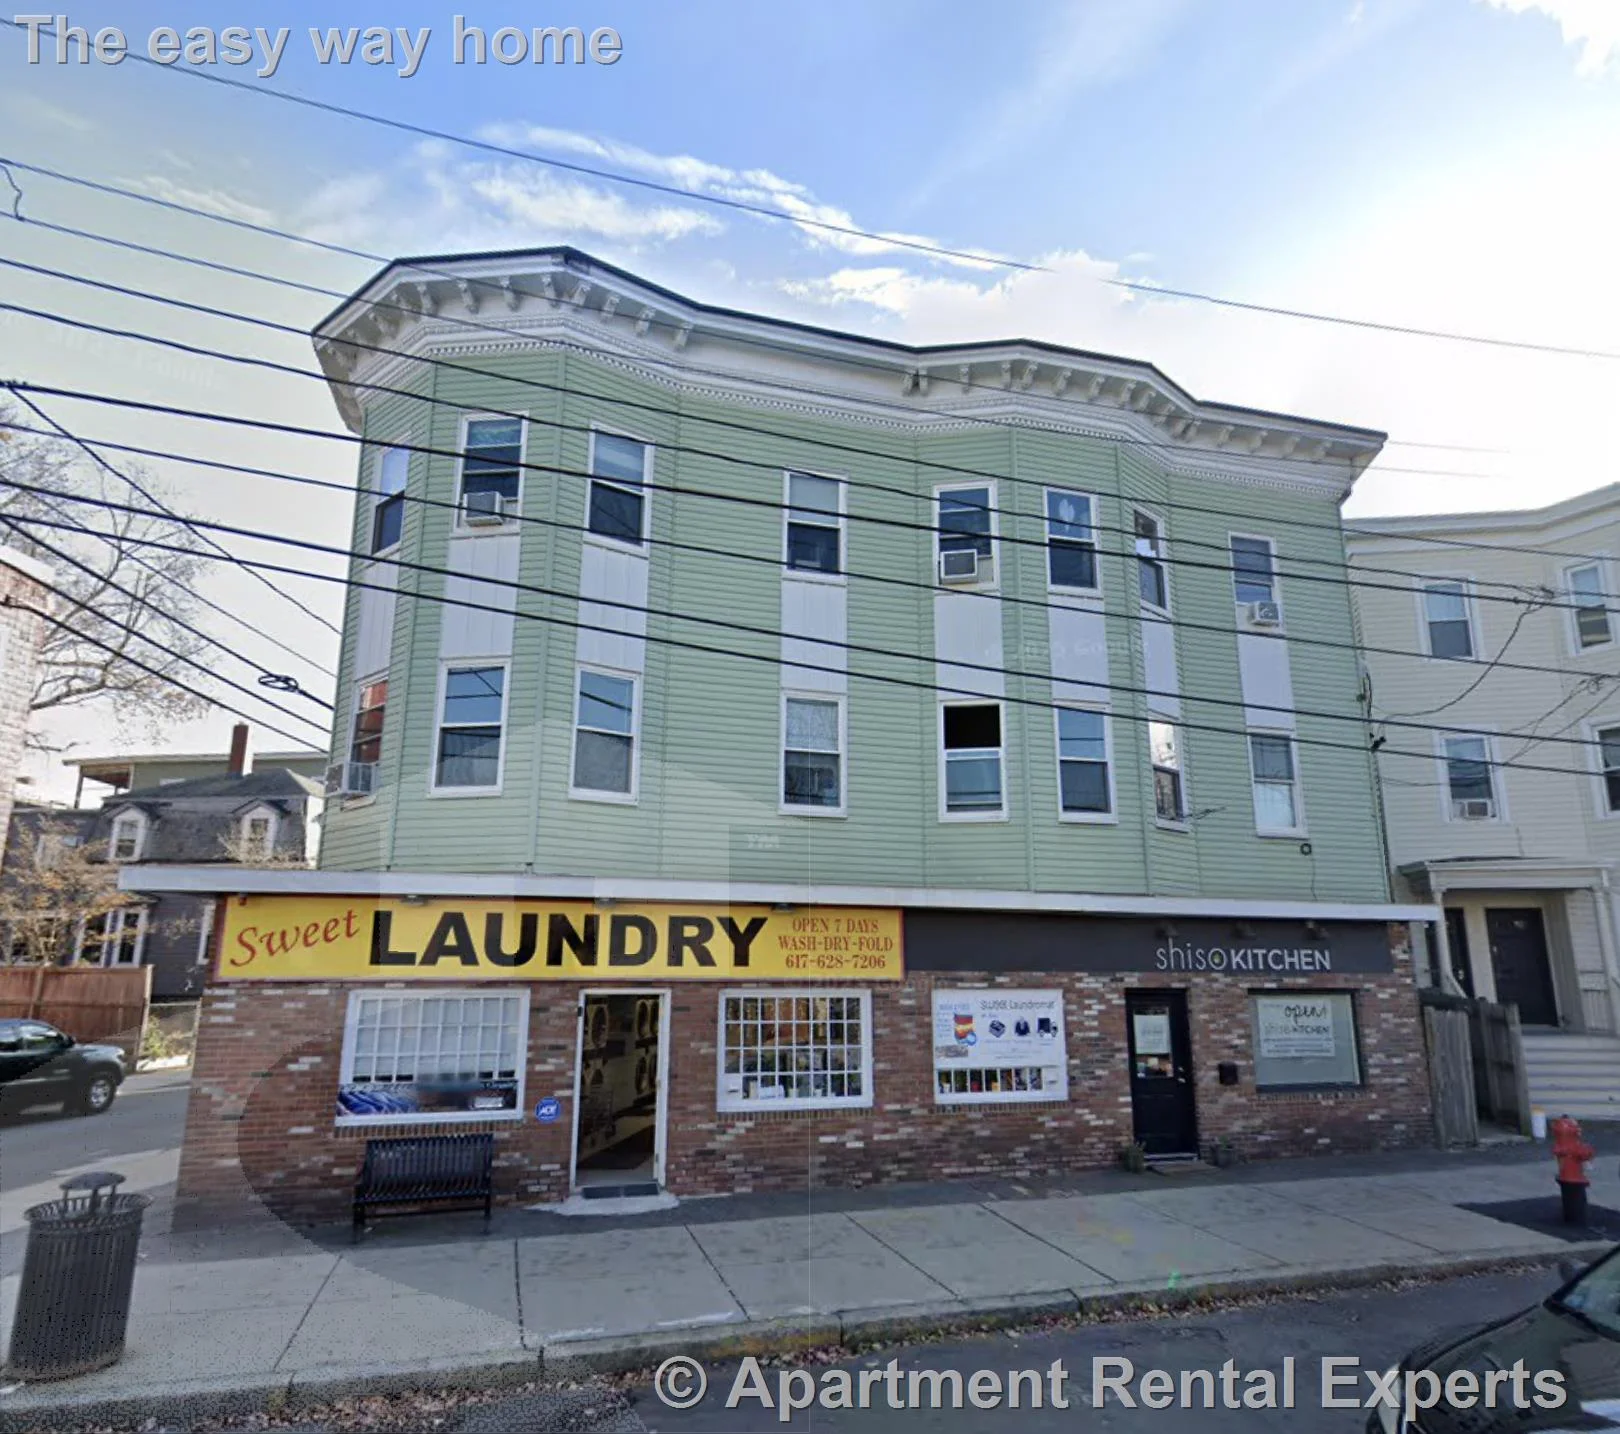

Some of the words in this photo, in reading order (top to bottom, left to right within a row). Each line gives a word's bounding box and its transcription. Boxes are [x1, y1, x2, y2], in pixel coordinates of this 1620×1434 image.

[792, 918, 829, 932] OPEN
[834, 919, 841, 932] 7
[846, 919, 879, 933] DAYS
[230, 908, 361, 967] Sweet
[369, 910, 768, 969] LAUNDRY
[778, 935, 893, 952] WASH-DRY-FOLD
[785, 954, 886, 969] 617-628-7206
